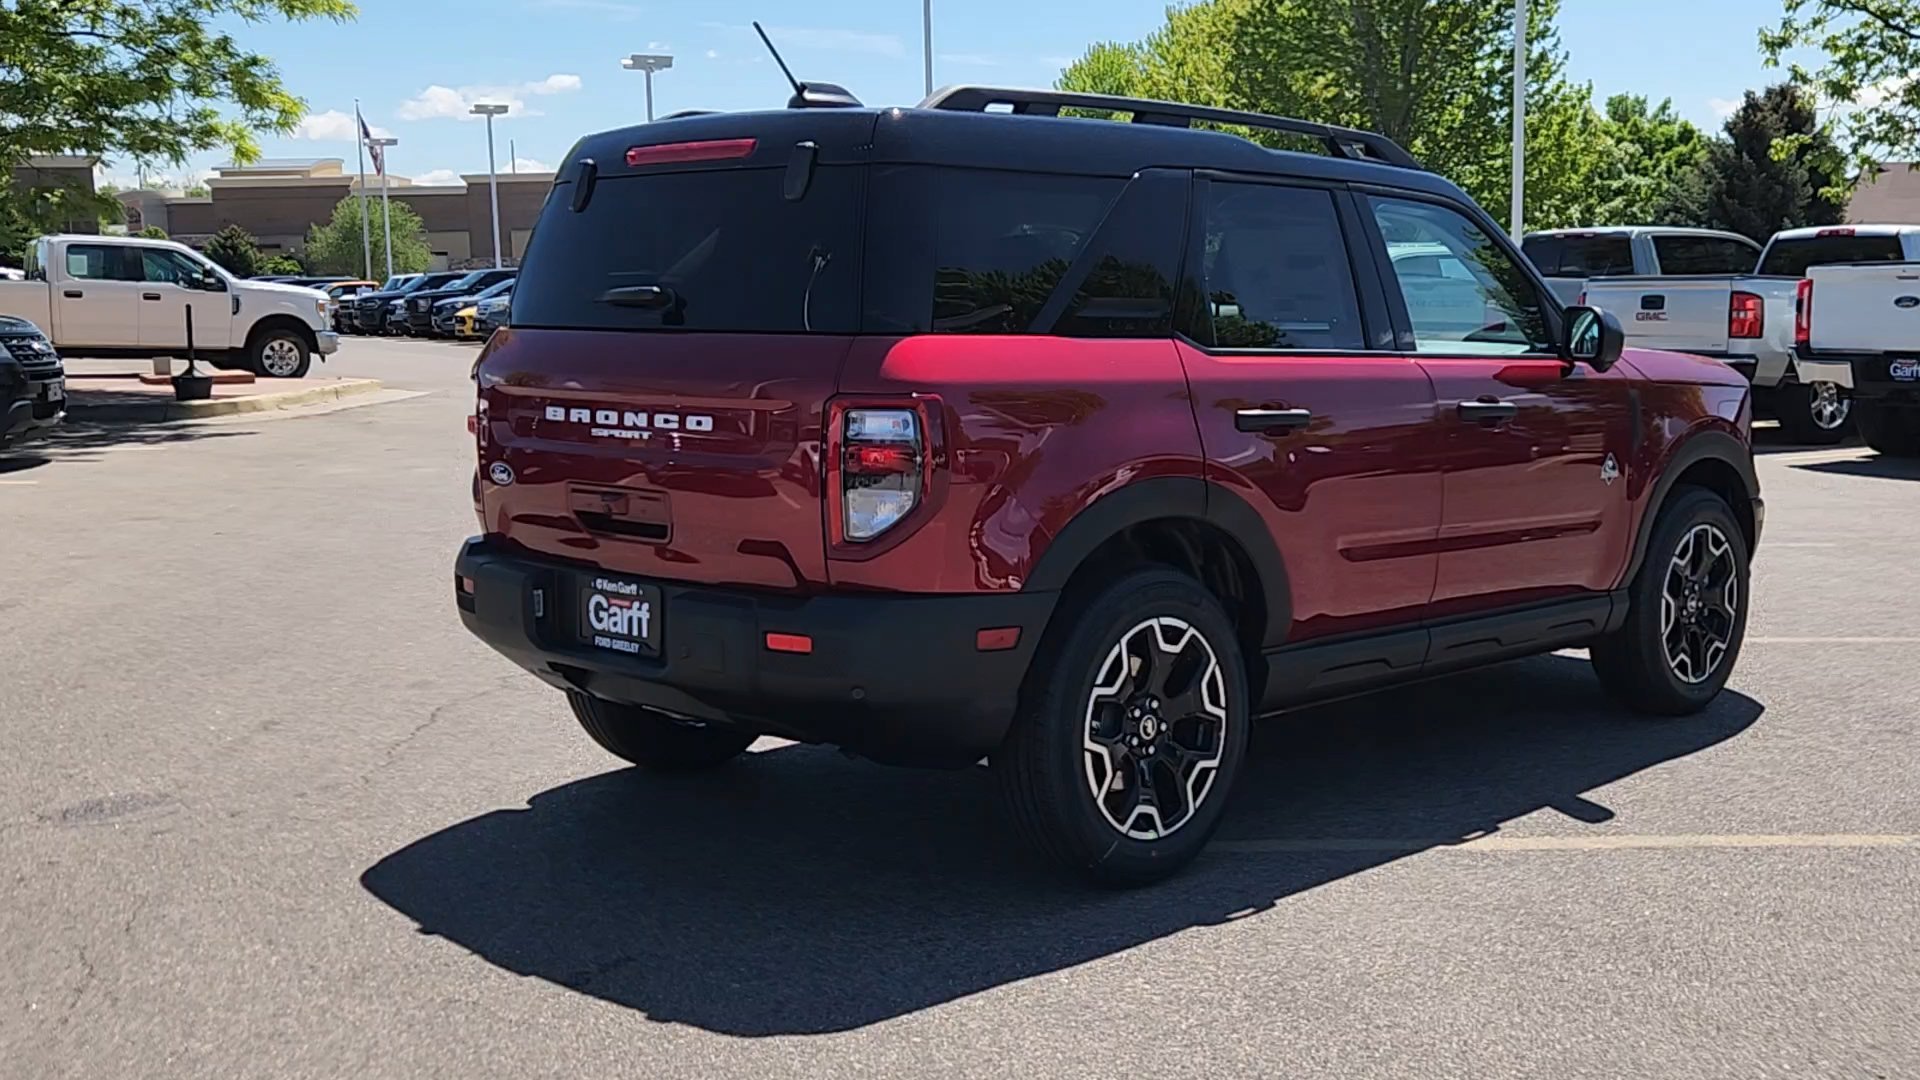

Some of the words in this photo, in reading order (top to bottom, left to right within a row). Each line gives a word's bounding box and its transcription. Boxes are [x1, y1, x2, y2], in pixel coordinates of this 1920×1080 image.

[1635, 312, 1668, 321] GMC
[545, 405, 714, 432] BRONCO
[590, 427, 653, 440] SPORT
[588, 593, 650, 638] Garff
